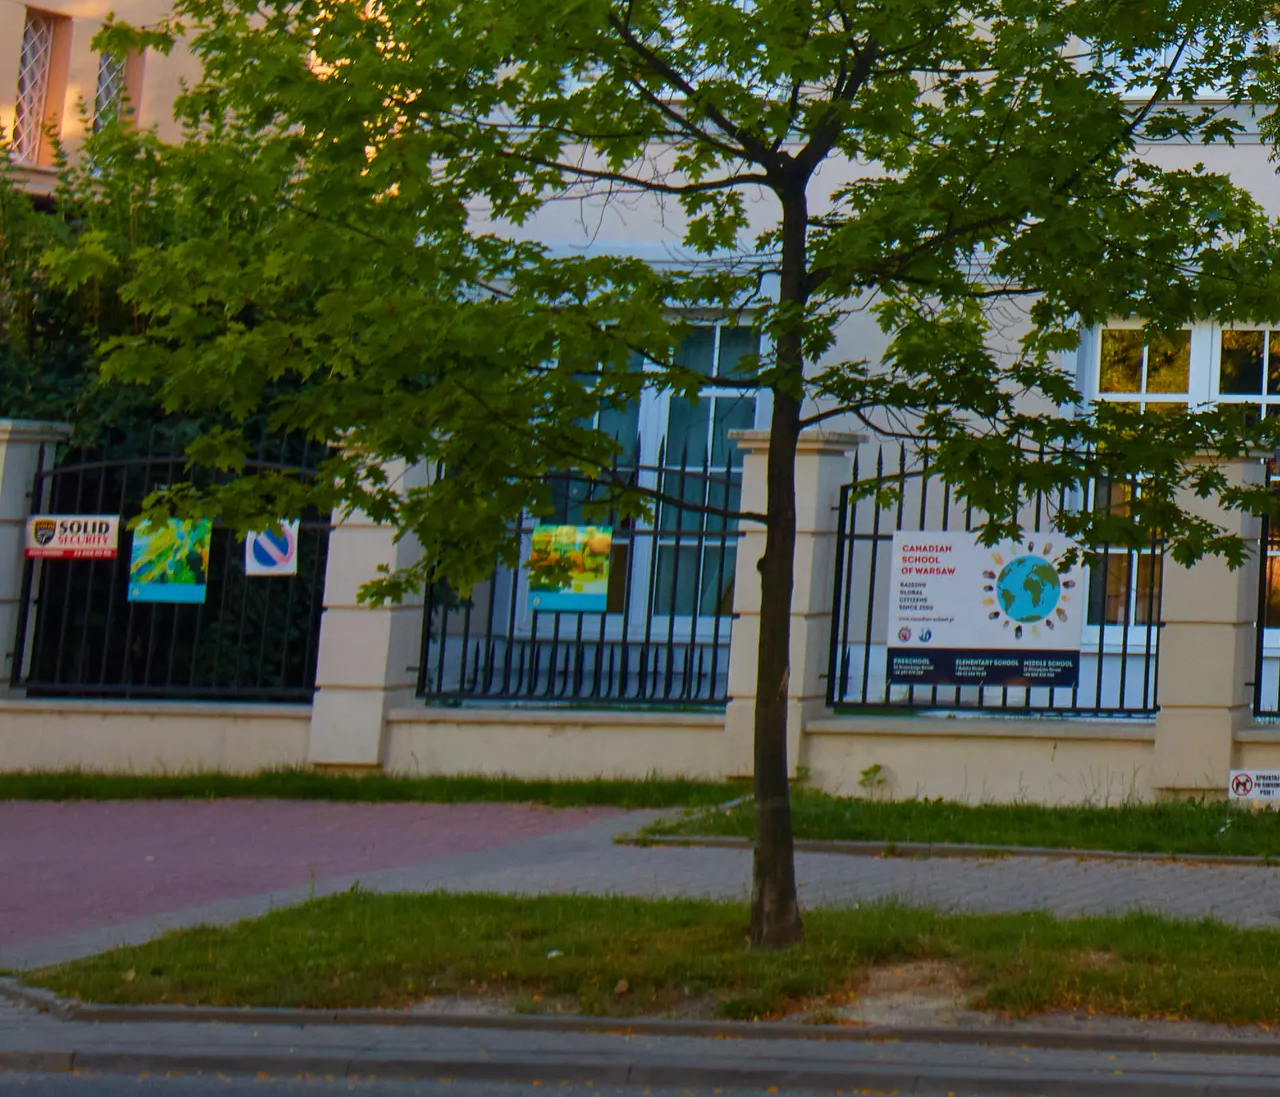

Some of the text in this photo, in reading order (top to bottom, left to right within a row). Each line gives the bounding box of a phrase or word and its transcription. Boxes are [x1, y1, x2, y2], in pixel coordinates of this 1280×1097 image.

[59, 520, 110, 535] SOLID
[58, 534, 109, 545] SECURITY
[902, 544, 952, 553] CANADIAN
[901, 555, 941, 564] SCHOOL
[901, 566, 956, 576] OF WARSAW
[893, 657, 930, 665] PRESCHOOL
[955, 658, 1019, 667] ELEMENTARY SCHOOL
[1023, 659, 1073, 668] MIDDLE SCHOOL
